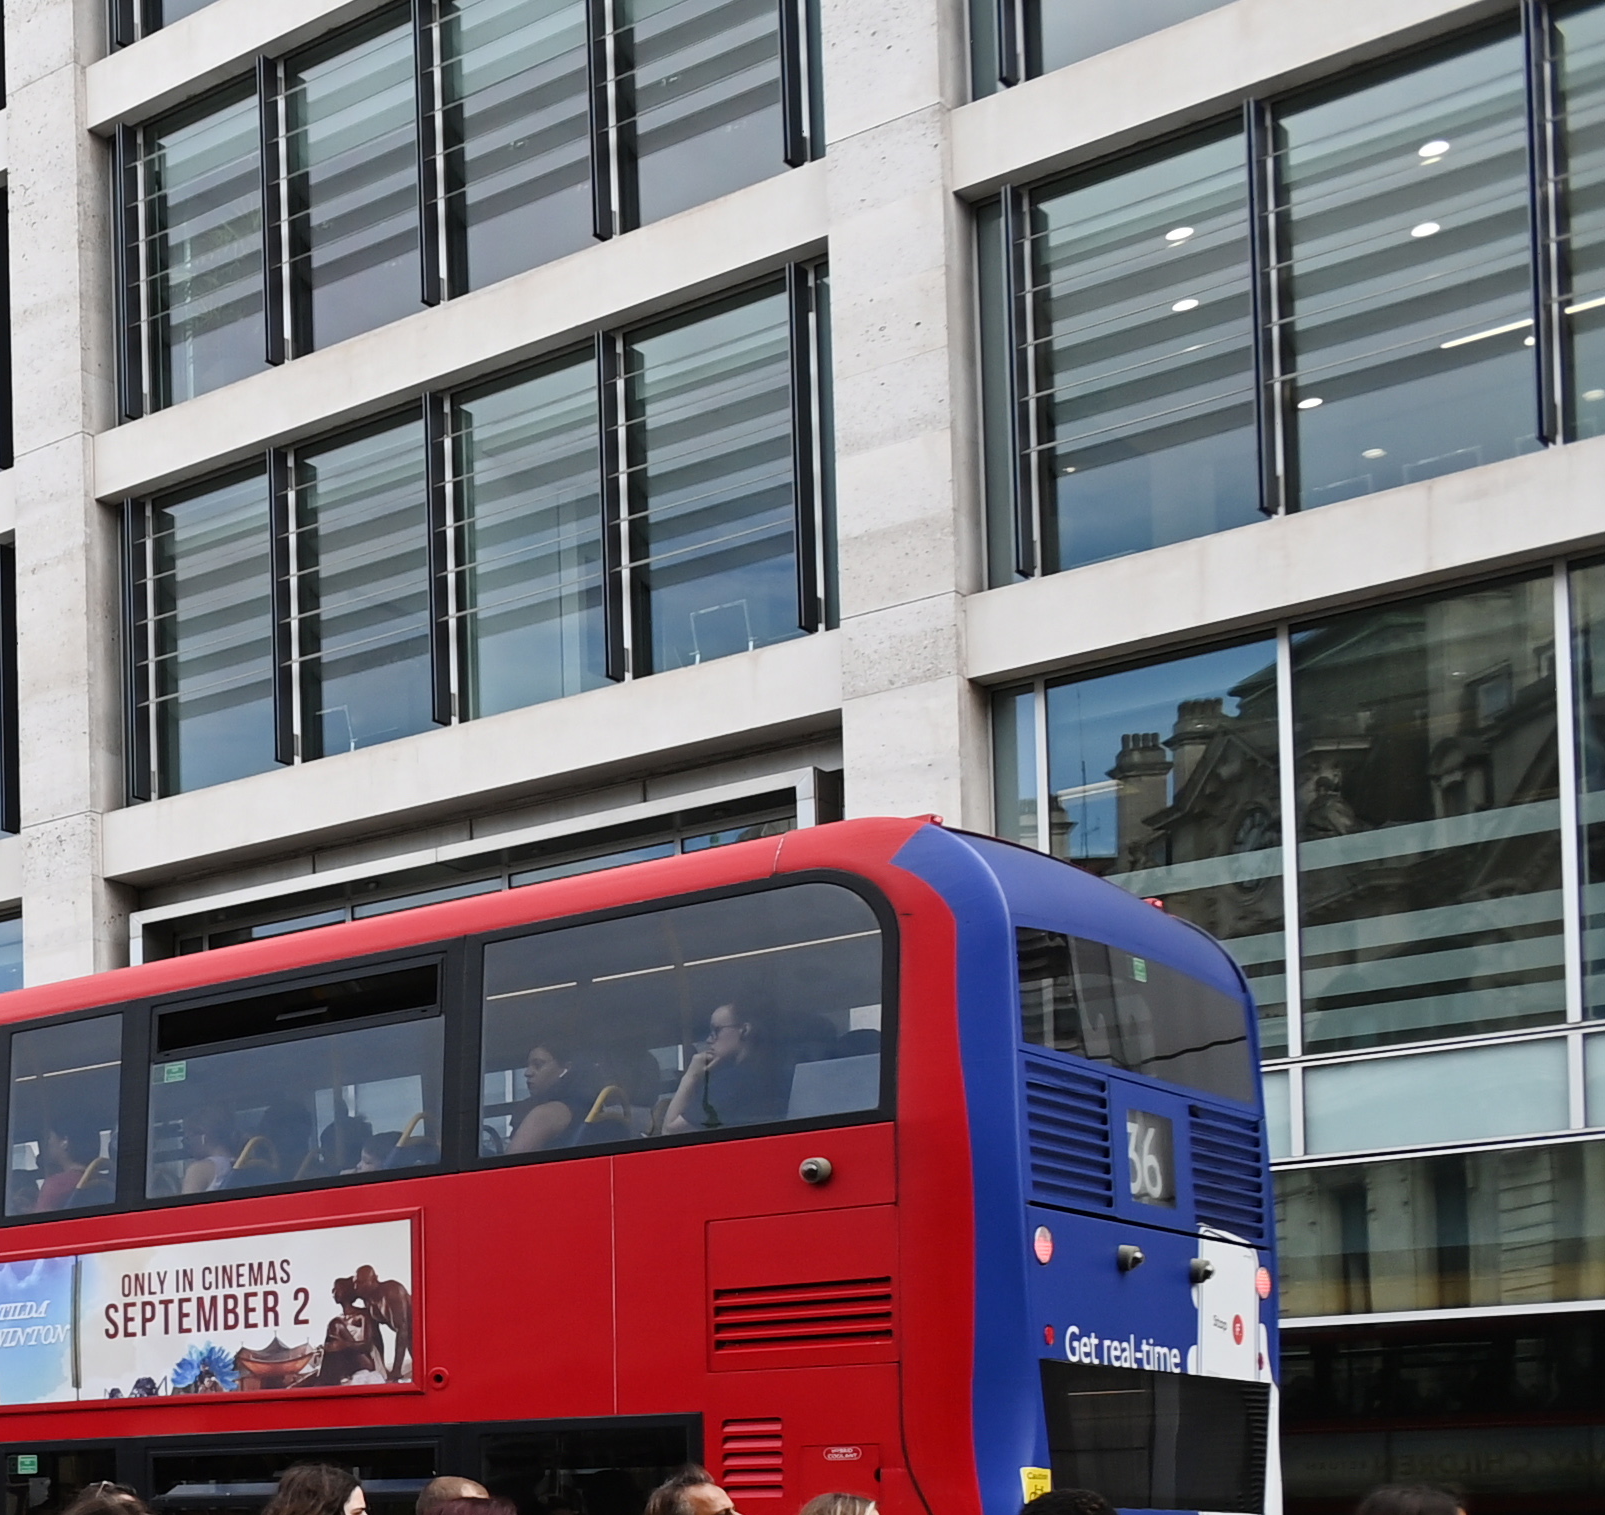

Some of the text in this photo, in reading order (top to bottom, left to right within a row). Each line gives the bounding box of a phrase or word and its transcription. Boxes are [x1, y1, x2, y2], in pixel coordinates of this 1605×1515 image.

[1126, 1121, 1163, 1199] 36
[121, 1258, 292, 1298] ONLY IN CINEMAS
[104, 1287, 310, 1340] SEPTEMBER 2
[1065, 1325, 1182, 1374] Get real-time
